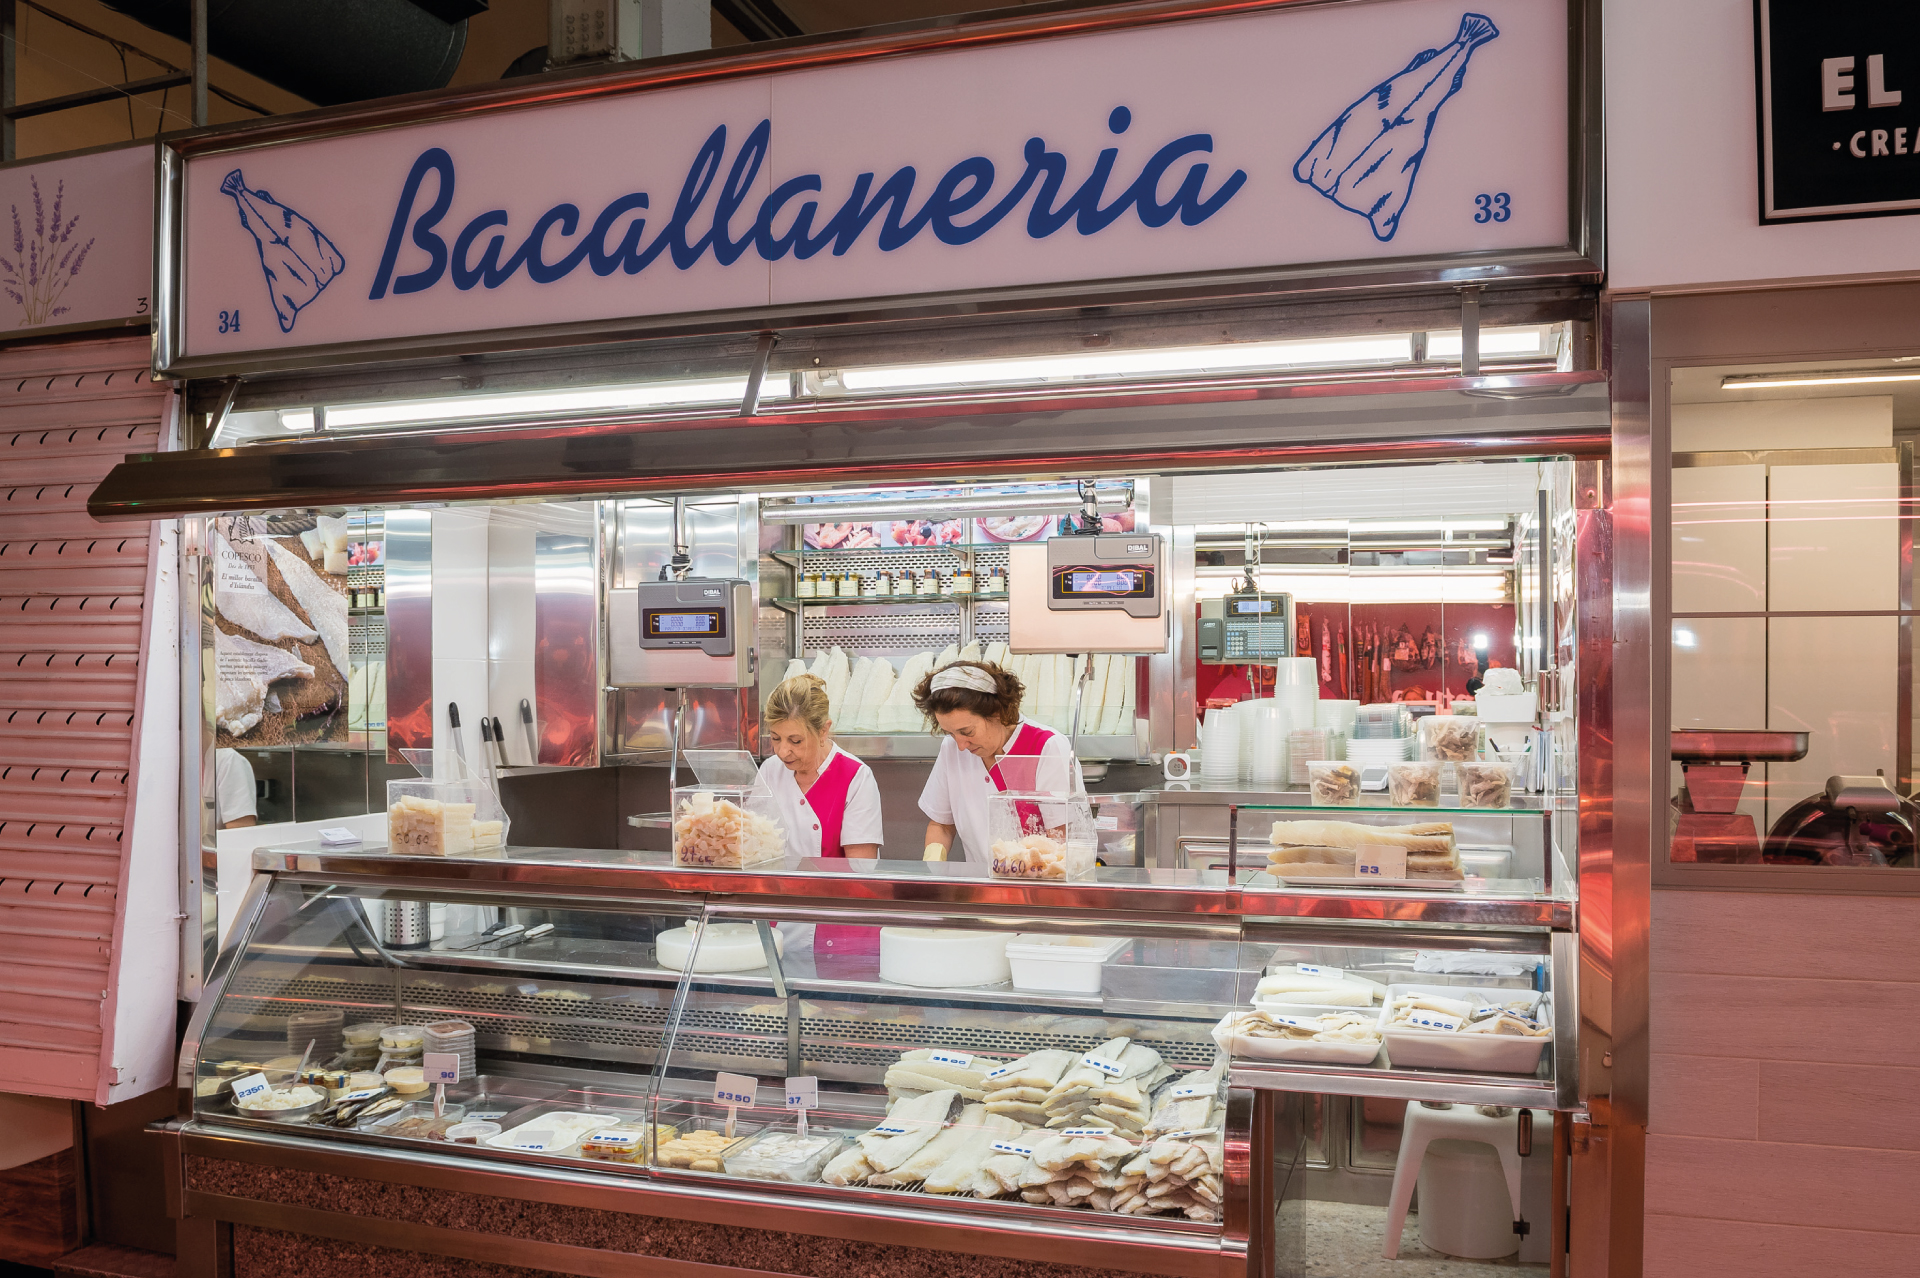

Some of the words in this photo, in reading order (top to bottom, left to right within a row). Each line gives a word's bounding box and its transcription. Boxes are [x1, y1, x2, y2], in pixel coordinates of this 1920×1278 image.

[1821, 54, 1902, 112] EL
[369, 106, 1247, 300] Bacallaneria
[1473, 192, 1512, 224] 33
[218, 309, 241, 334] 34
[221, 550, 262, 563] COPESCO
